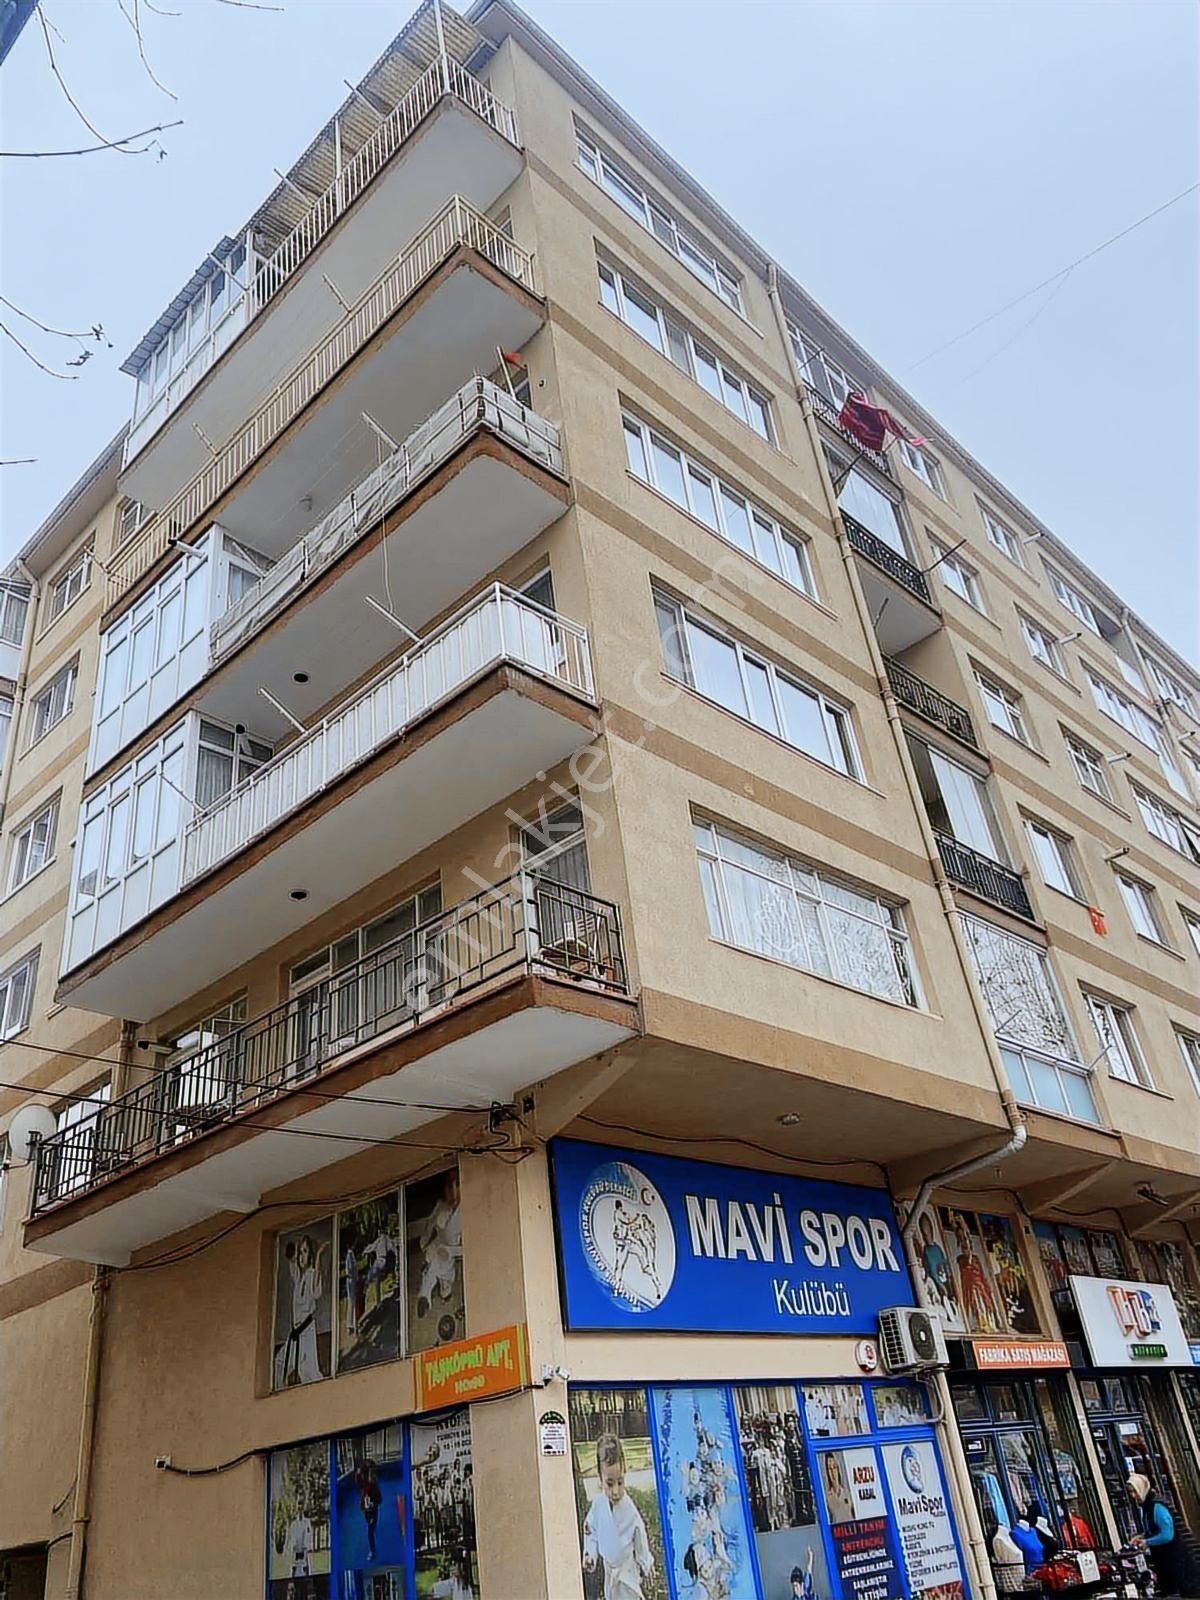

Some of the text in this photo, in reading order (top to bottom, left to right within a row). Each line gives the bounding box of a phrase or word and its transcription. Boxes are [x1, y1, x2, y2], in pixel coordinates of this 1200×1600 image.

[685, 1192, 900, 1271] MAVİ SPOR
[772, 1279, 850, 1316] Kulübü
[853, 1466, 875, 1484] ARZU
